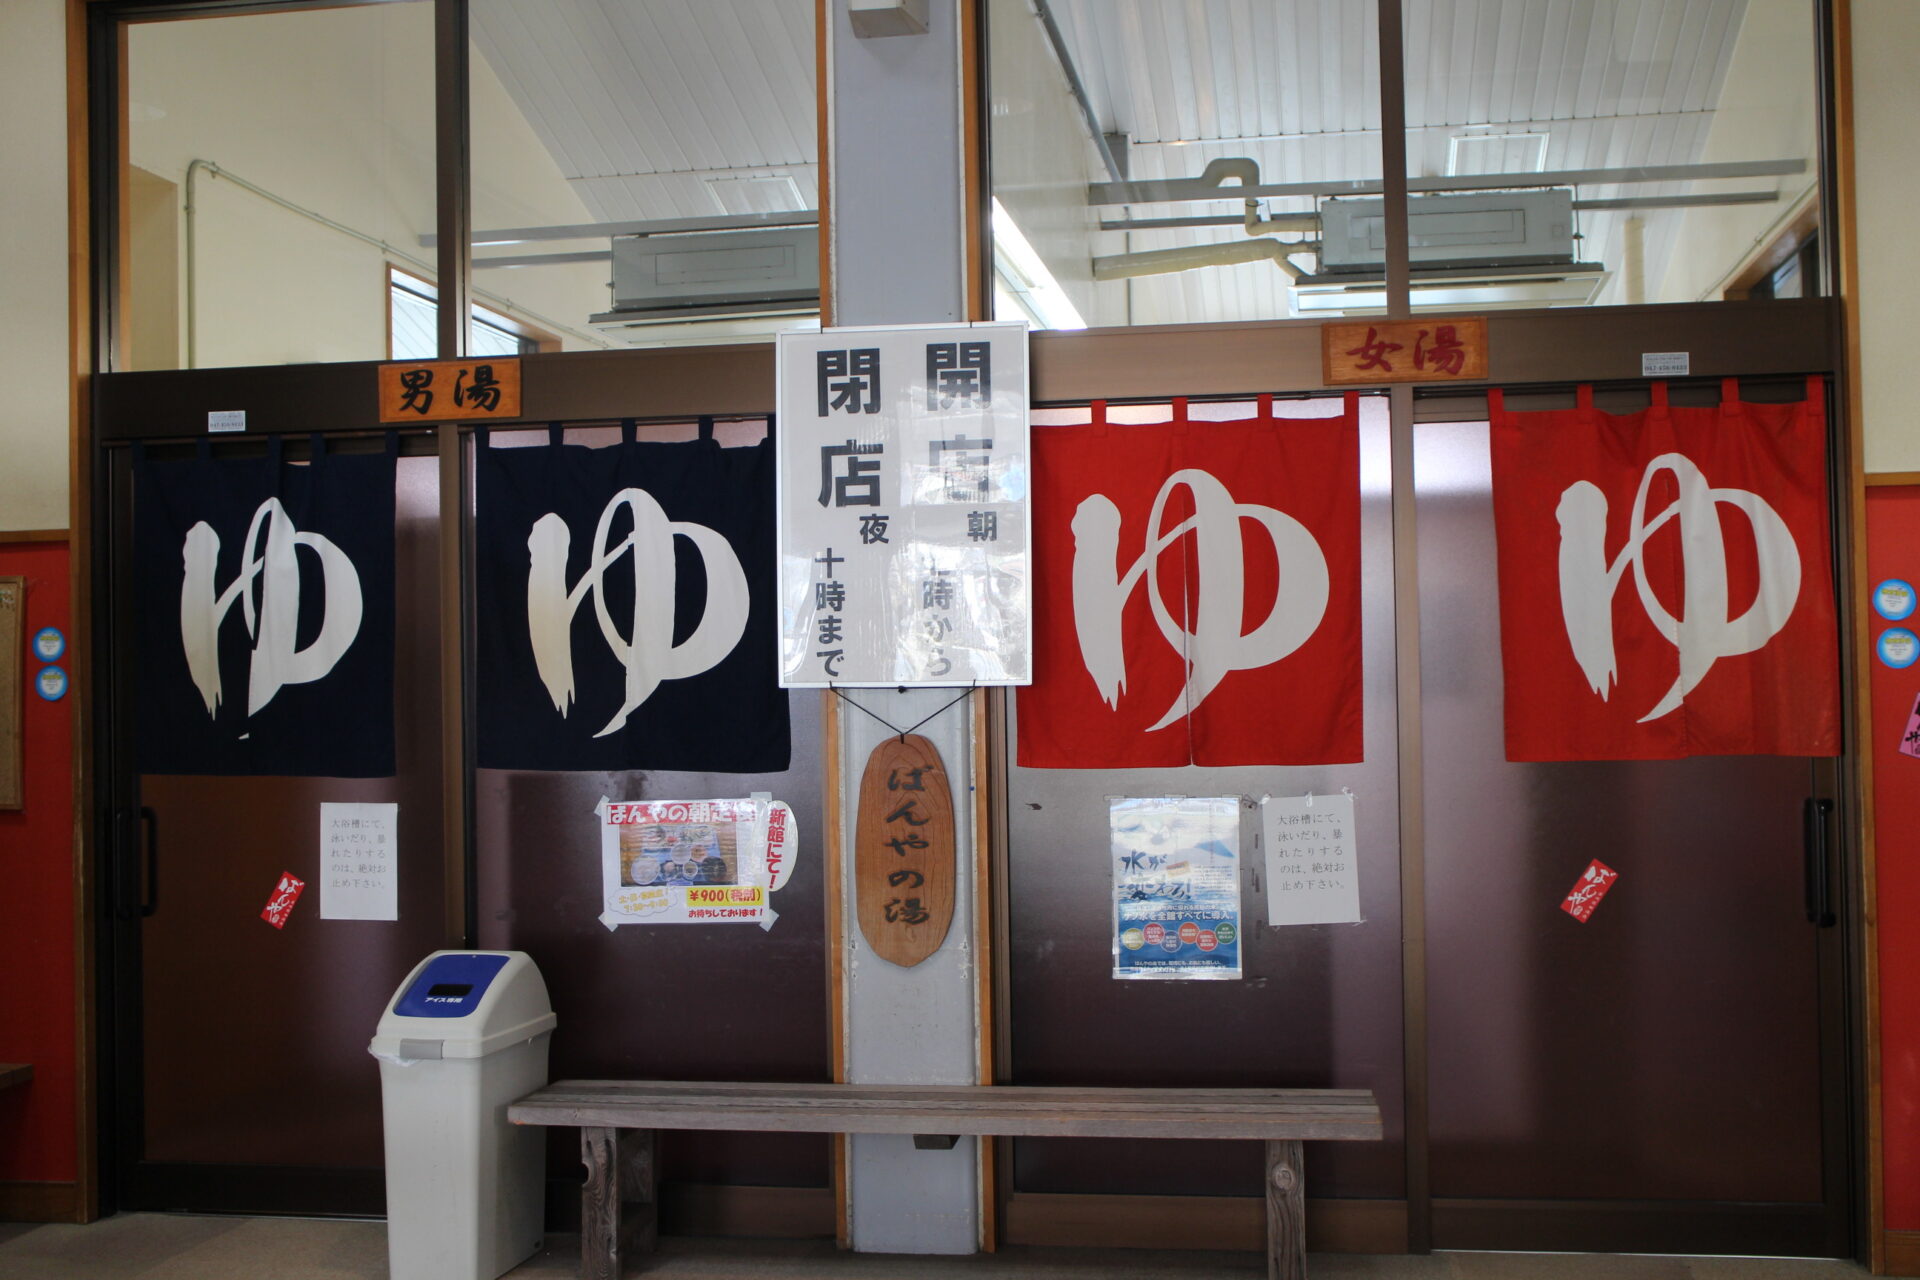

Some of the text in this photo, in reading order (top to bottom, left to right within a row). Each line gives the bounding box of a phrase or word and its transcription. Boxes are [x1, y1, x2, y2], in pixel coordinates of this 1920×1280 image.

[399, 365, 500, 414] 男湯
[1346, 325, 1465, 375] 女湯
[817, 348, 884, 508] 閉店
[859, 514, 889, 545] 夜
[967, 511, 997, 542] 朝
[1556, 452, 1802, 724] ゆ
[180, 496, 363, 739] ゆ
[527, 487, 750, 738] ゆ
[815, 548, 845, 677] 十時まで
[1072, 468, 1330, 732] ゆ
[884, 766, 933, 925] ばんやの湯
[1279, 846, 1343, 858] れたりする
